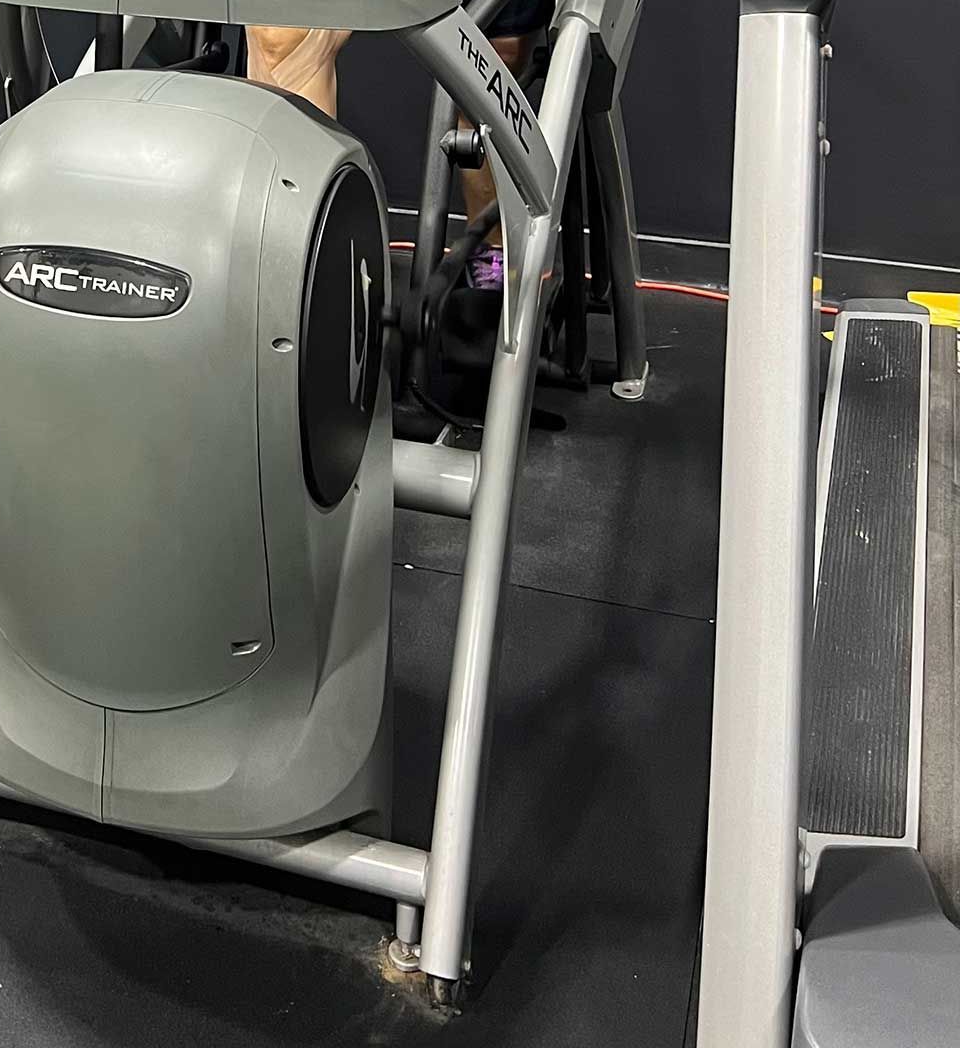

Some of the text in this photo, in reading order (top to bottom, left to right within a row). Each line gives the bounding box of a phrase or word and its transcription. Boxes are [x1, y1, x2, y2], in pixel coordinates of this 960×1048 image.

[458, 27, 533, 155] THE ARC
[3, 261, 80, 292] ARC
